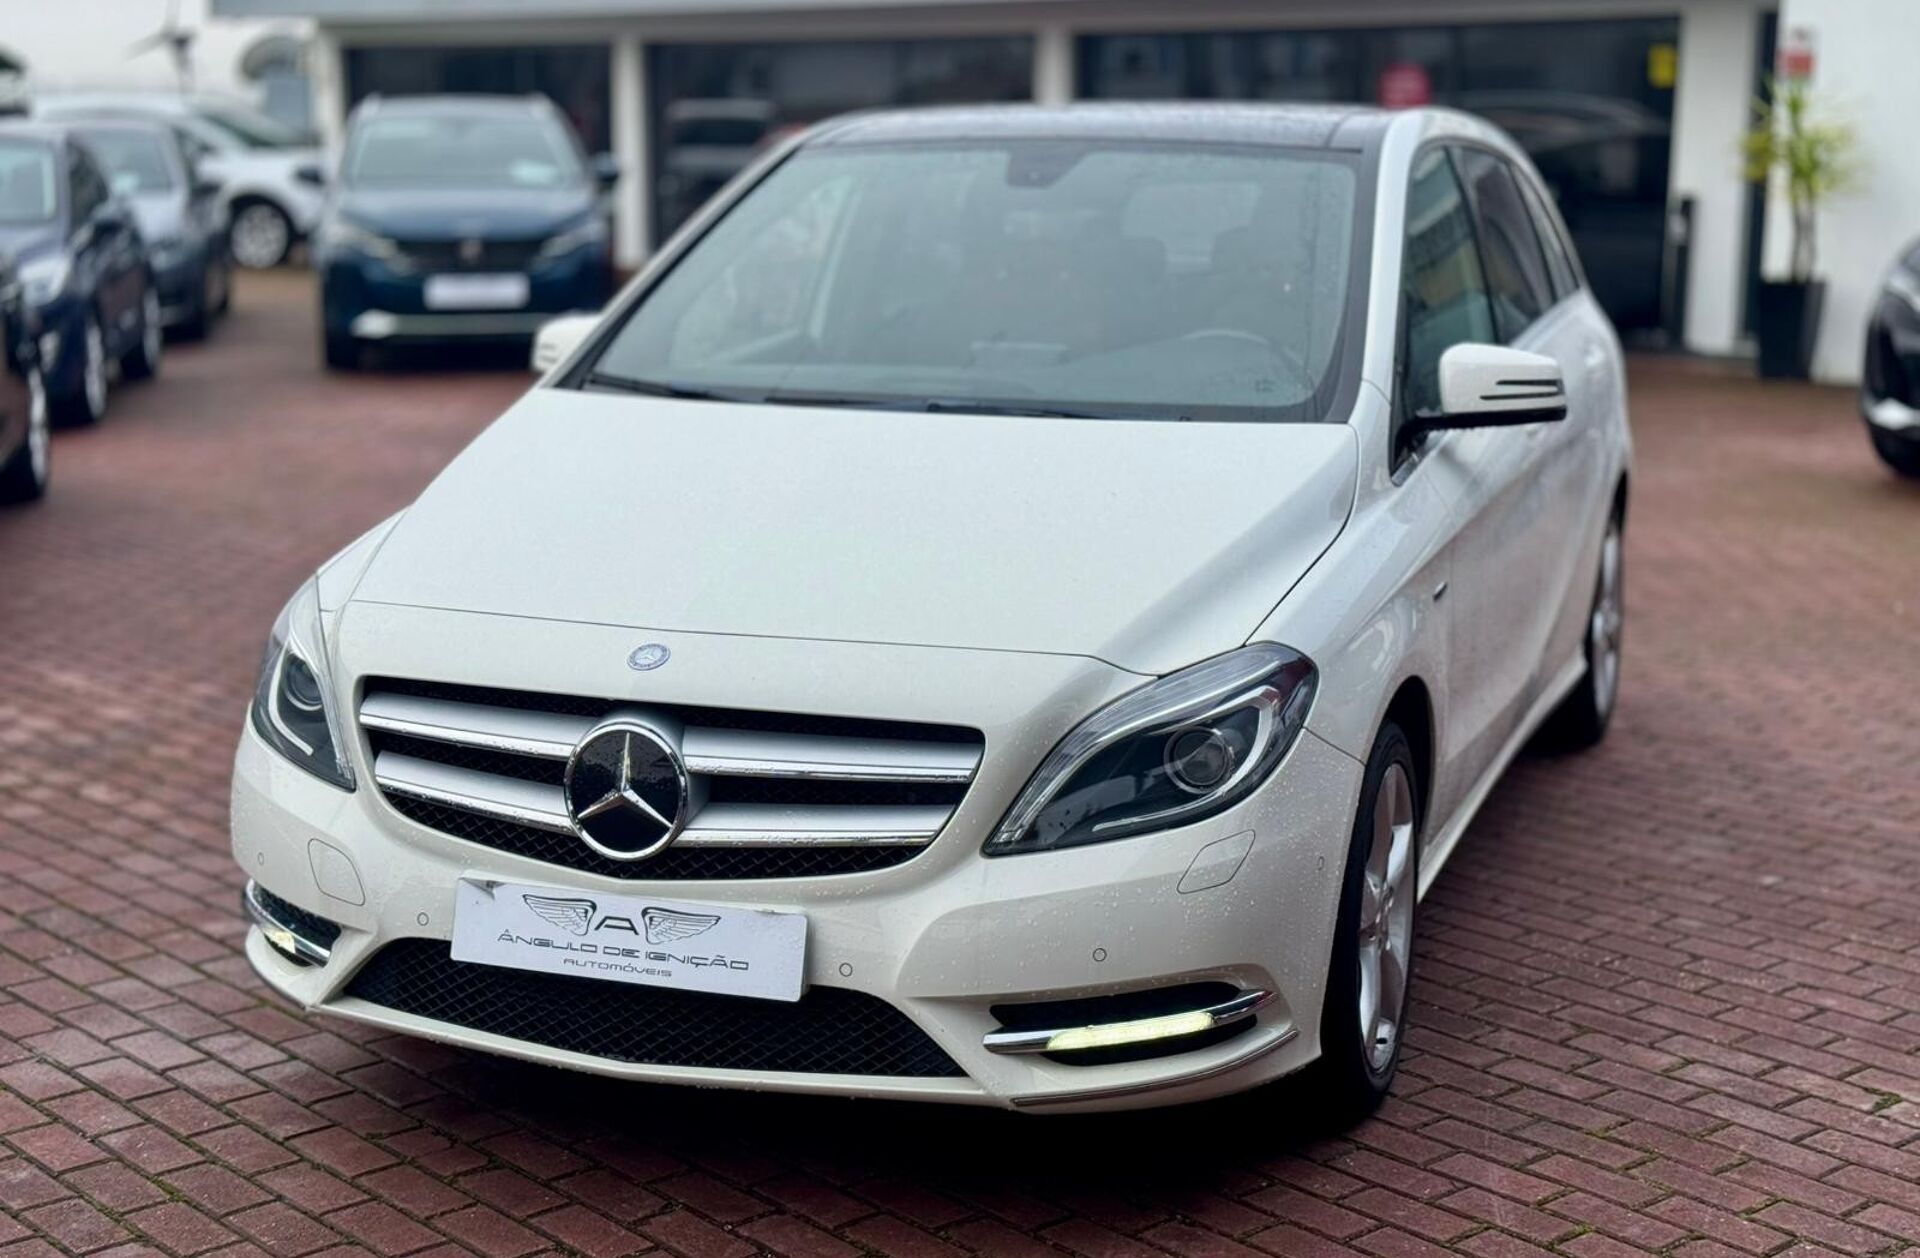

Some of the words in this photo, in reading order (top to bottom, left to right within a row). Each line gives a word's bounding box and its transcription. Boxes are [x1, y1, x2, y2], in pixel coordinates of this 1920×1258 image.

[594, 915, 640, 936] A
[497, 929, 598, 953] ÂNGULO
[603, 946, 640, 959] DE
[645, 951, 750, 971] IGNIÇÃO
[563, 958, 673, 978] AUTOMÓVEIS
